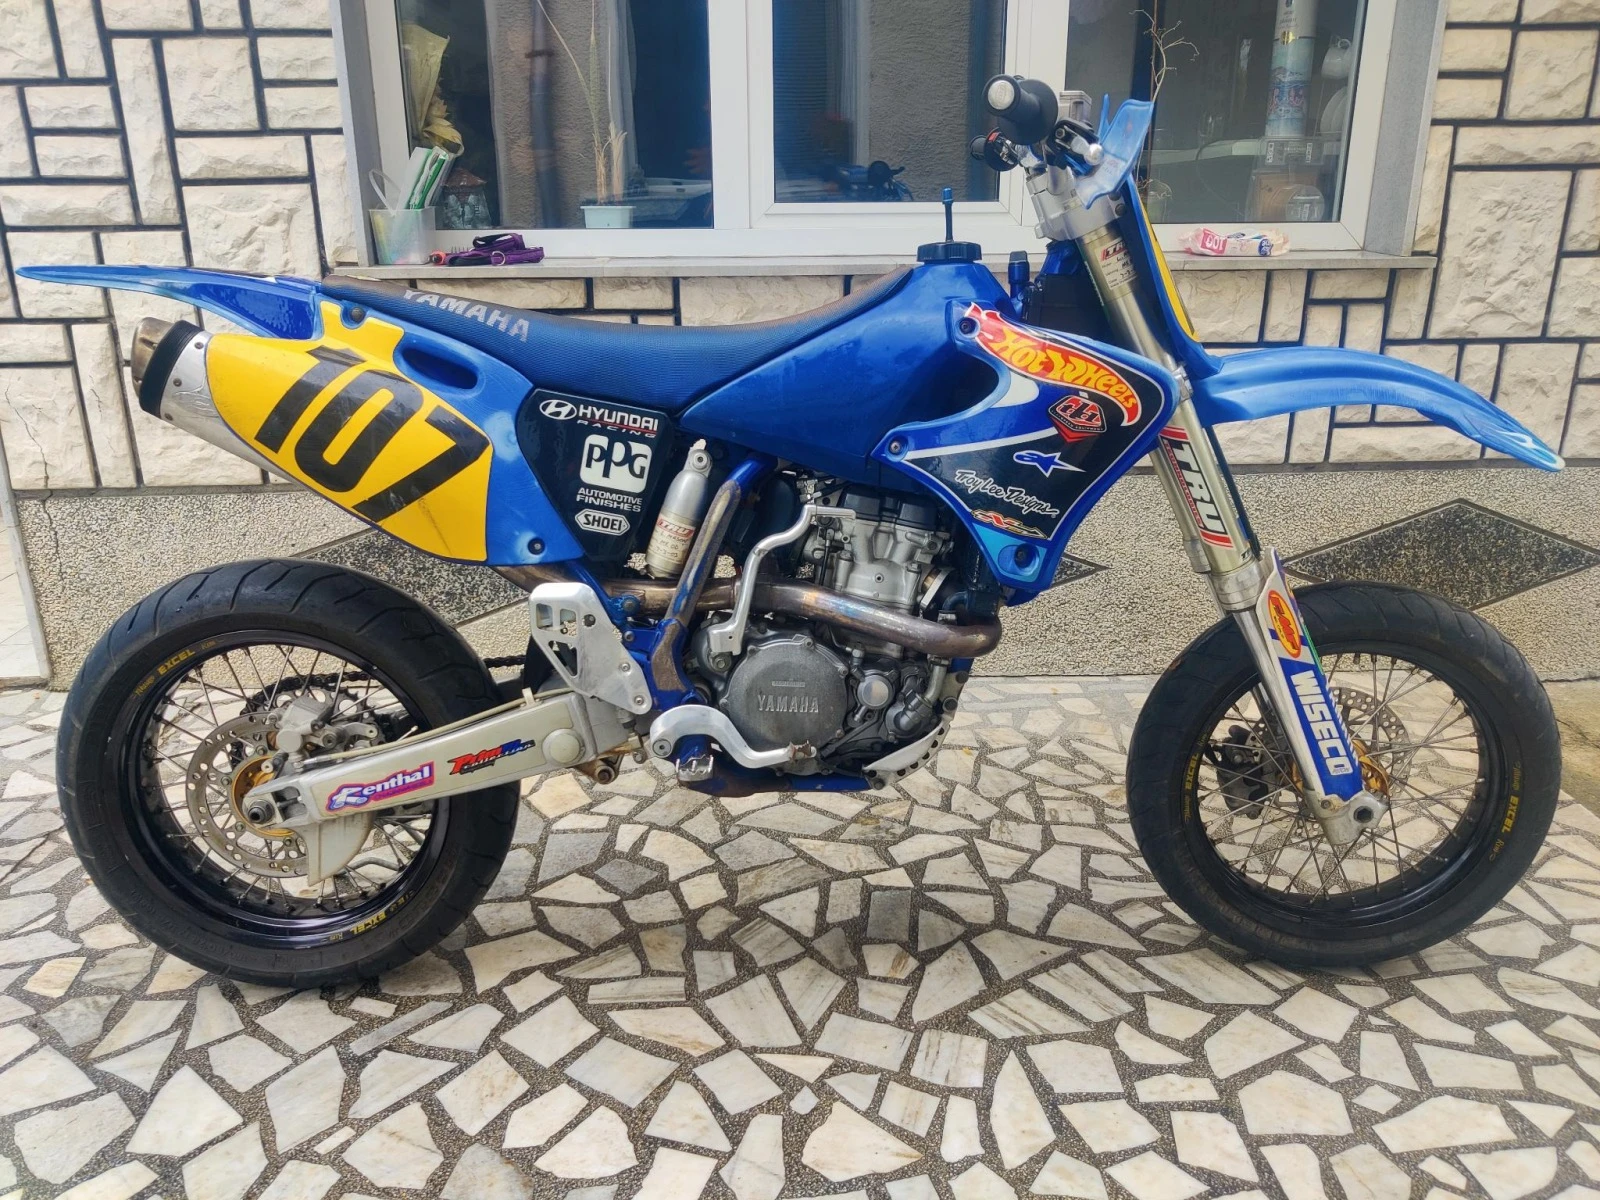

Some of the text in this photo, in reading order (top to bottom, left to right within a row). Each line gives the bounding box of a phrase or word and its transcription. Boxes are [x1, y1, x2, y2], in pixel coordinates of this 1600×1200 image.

[403, 289, 529, 342] YAMAHA
[254, 345, 491, 523] 107
[577, 419, 656, 439] RACING
[578, 404, 658, 431] HYUNDAI
[584, 437, 648, 479] PPG
[576, 494, 641, 512] FINISHES
[578, 487, 643, 505] AUTOMOTIVE
[955, 470, 1060, 515] Troy Lee Designs
[1171, 441, 1227, 534] TRU
[583, 514, 623, 531] SHOEI
[1270, 595, 1301, 651] FMF
[157, 649, 196, 676] EXCEL
[758, 694, 819, 713] YAMAHA
[1290, 670, 1354, 776] WISECO
[330, 765, 431, 809] Renthal
[1185, 753, 1199, 790] EXCEL
[1502, 795, 1519, 833] EXCEL
[350, 911, 388, 935] EXCEL
